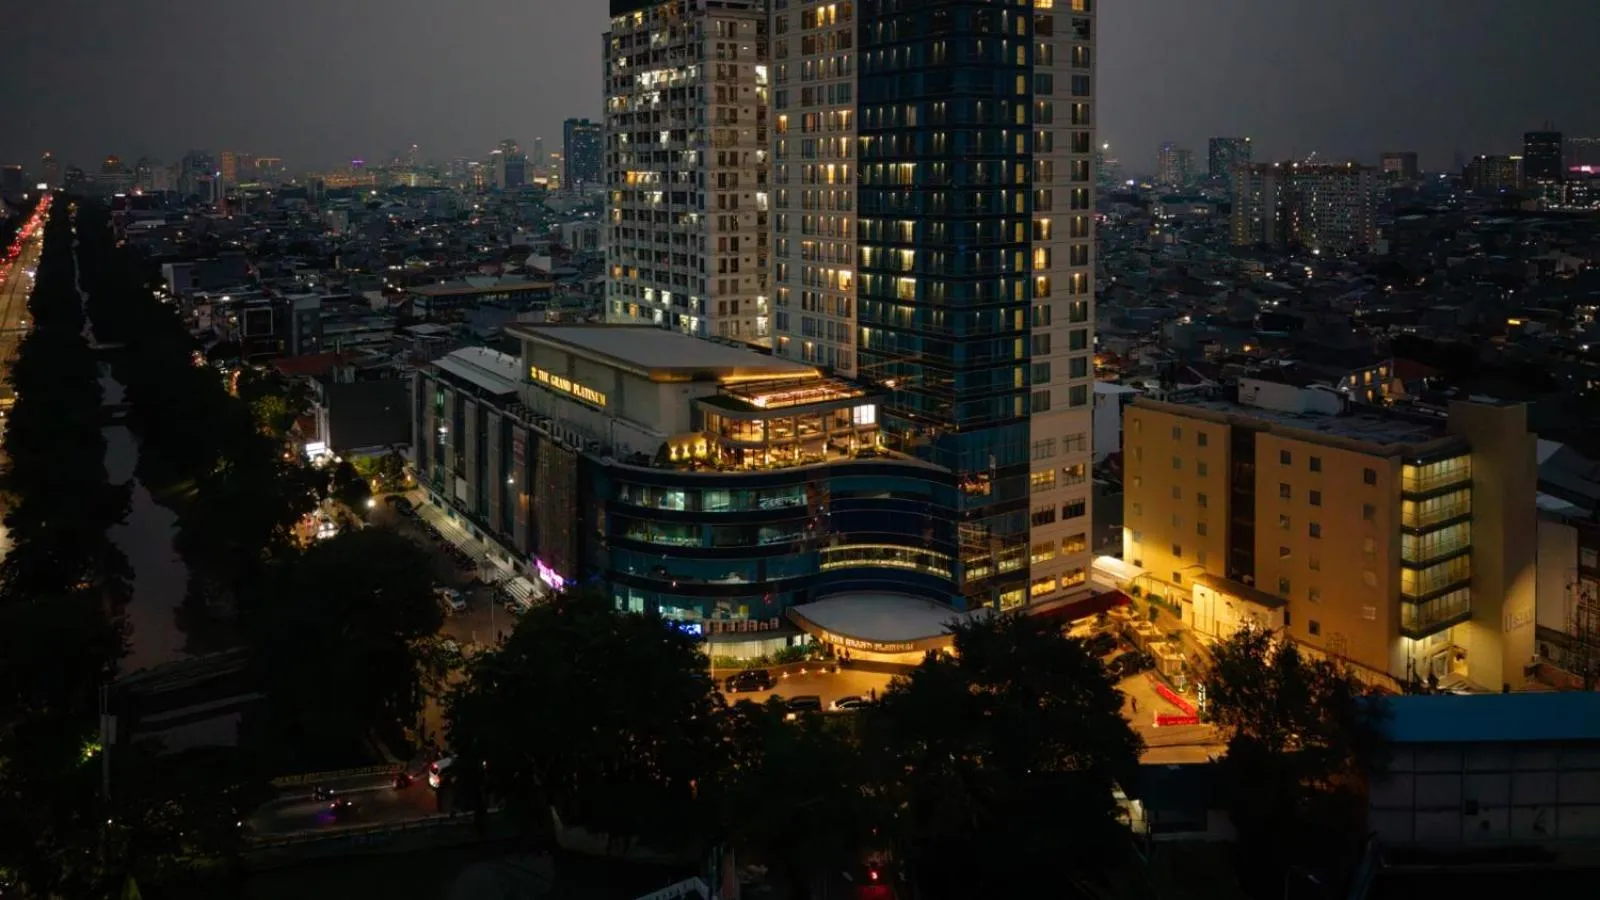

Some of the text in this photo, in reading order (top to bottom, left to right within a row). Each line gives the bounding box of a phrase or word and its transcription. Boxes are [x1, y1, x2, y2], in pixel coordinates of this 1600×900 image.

[538, 369, 606, 406] THE GRAND PLATINUM
